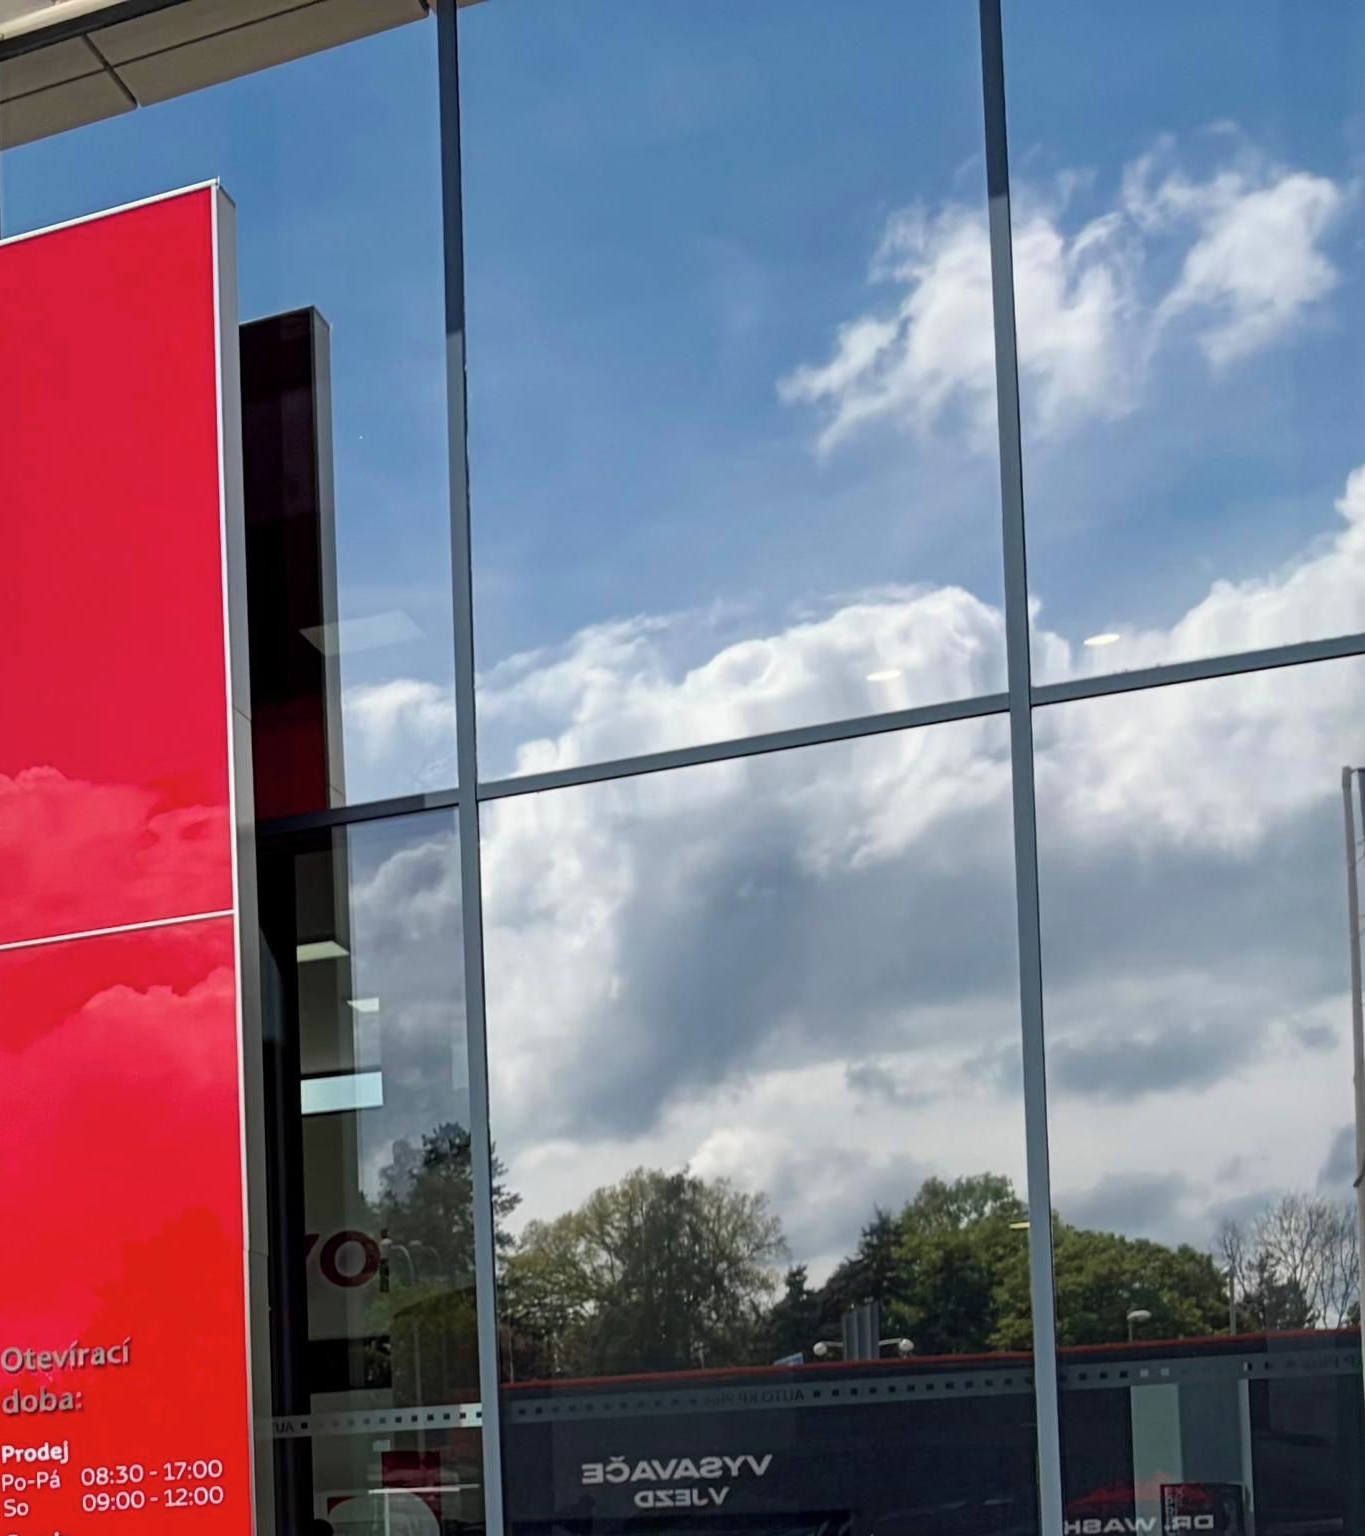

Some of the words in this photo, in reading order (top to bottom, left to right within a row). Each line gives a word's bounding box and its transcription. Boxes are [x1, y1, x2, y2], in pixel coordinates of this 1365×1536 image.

[0, 1337, 132, 1372] Otevírací
[1, 1388, 83, 1415] doba:
[1, 1440, 70, 1465] Prodej
[1, 1471, 62, 1492] Po-Pá
[80, 1464, 144, 1487] 08:30
[163, 1459, 223, 1482] 17:00
[4, 1498, 29, 1518] So
[82, 1490, 145, 1513] 09:00
[164, 1486, 224, 1509] 12:00
